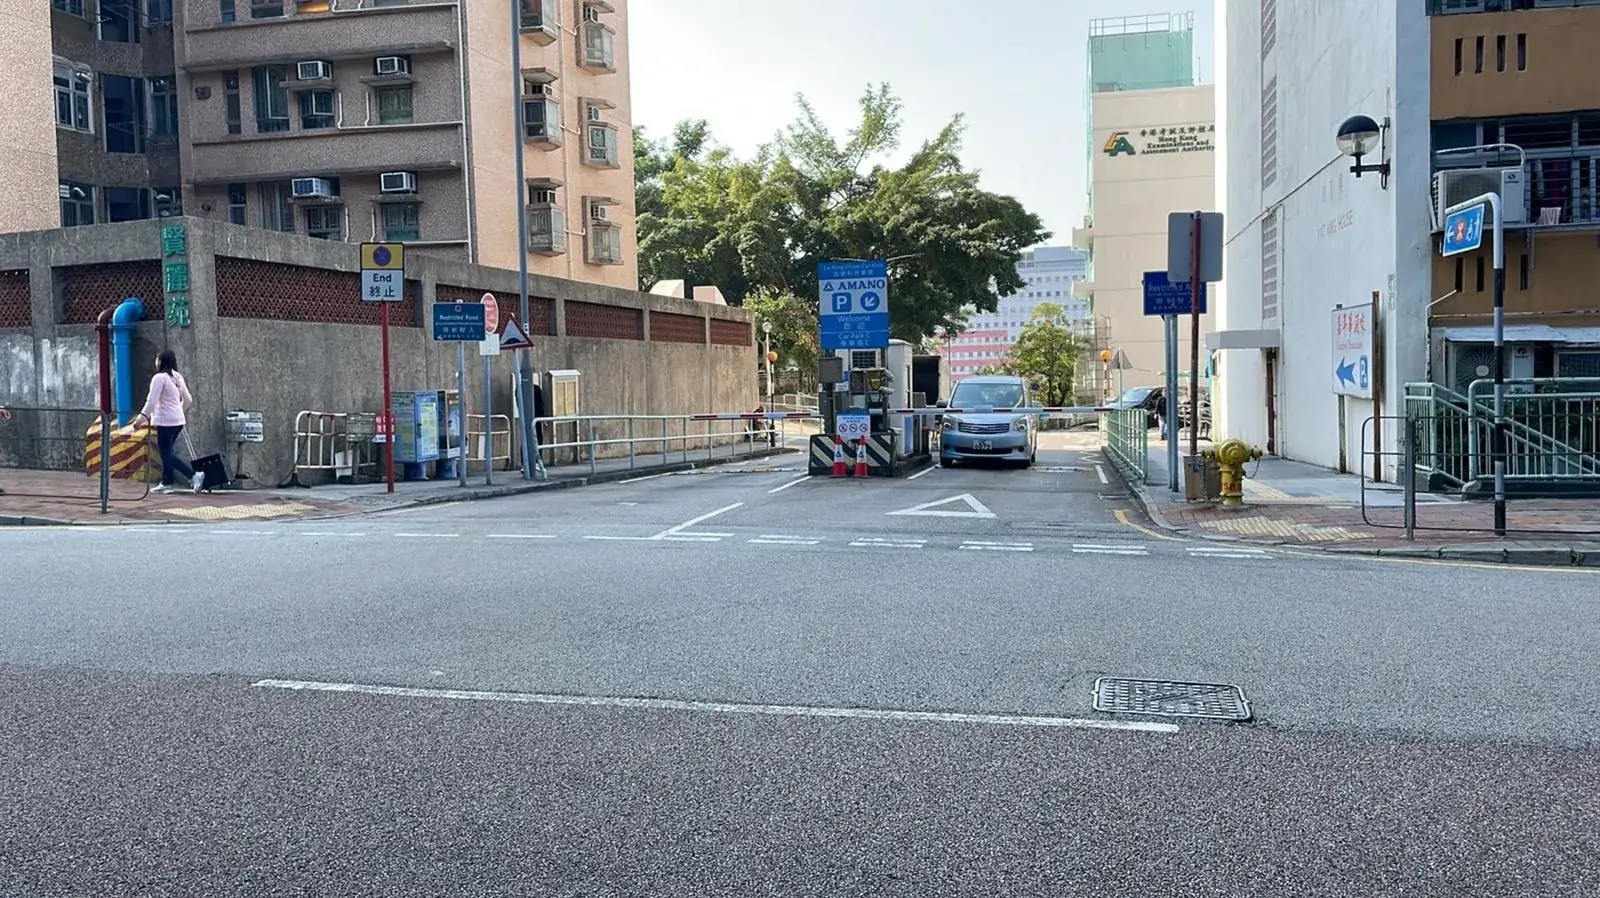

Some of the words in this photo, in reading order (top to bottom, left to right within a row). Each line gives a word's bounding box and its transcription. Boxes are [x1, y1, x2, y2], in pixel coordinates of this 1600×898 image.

[1147, 140, 1194, 149] Examinations
[1140, 146, 1179, 155] Assessment
[1181, 145, 1215, 153] Authority
[1337, 209, 1353, 230] HOUSE
[373, 273, 392, 283] End
[838, 279, 886, 291] AMANO
[369, 285, 396, 298] 終止
[465, 313, 480, 321] Road
[837, 315, 872, 323] Welcome
[838, 332, 850, 340] Car
[850, 331, 864, 339] Park
